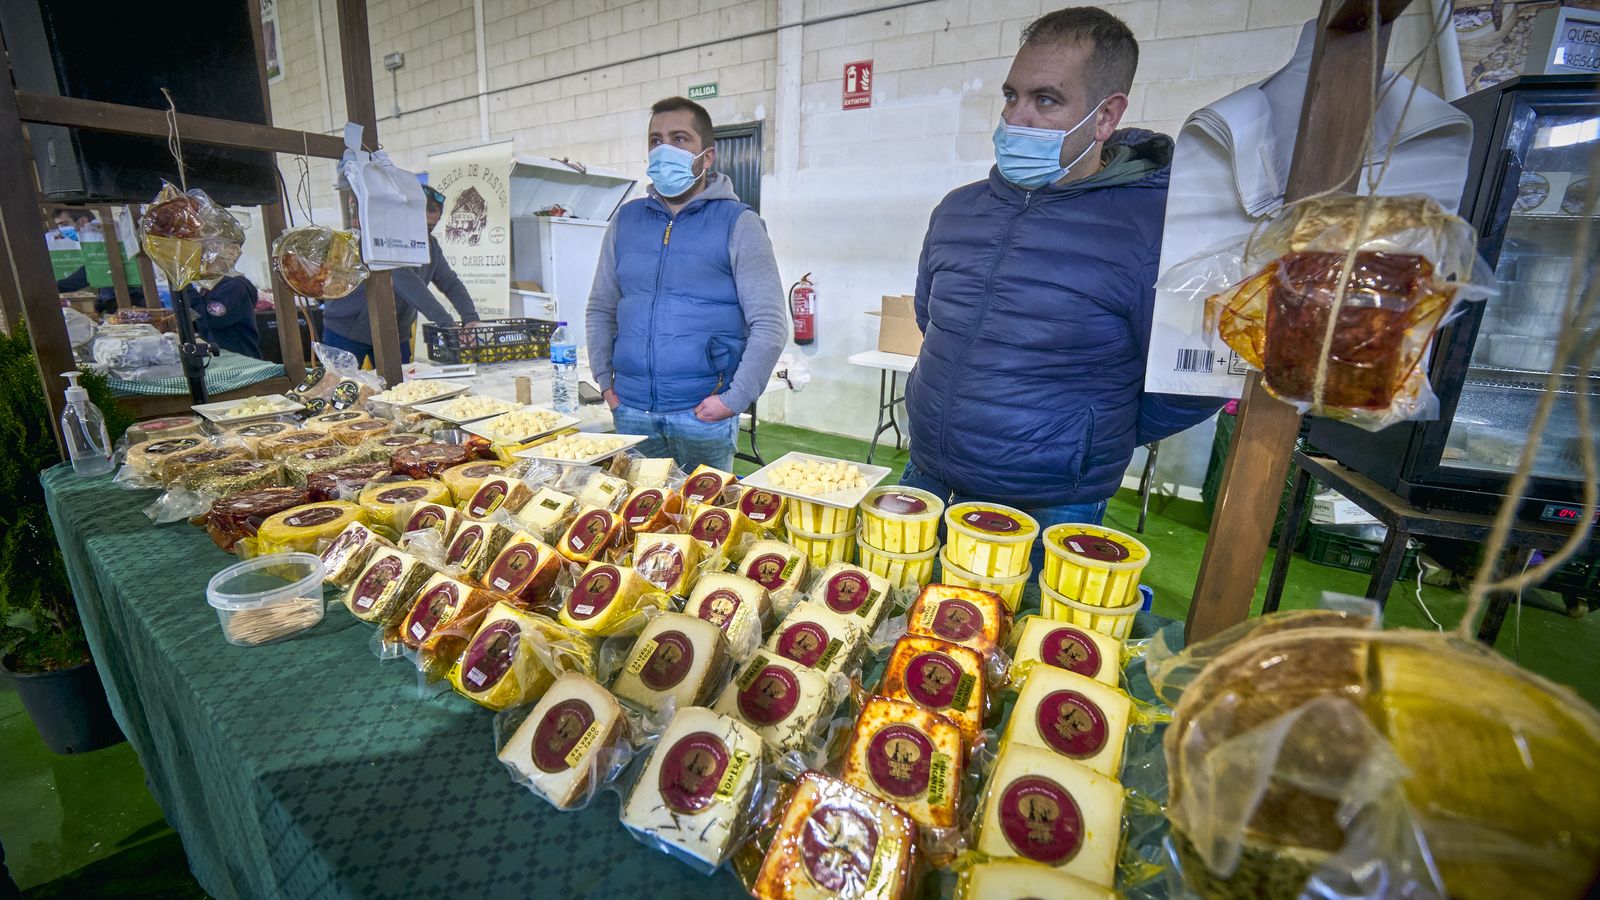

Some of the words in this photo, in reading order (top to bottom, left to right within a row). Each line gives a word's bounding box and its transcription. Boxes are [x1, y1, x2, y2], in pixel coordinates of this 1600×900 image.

[1568, 28, 1600, 44] QUES
[1566, 53, 1600, 69] RESCO
[690, 86, 716, 97] SALIDA
[844, 97, 869, 106] EXTINTOR
[437, 168, 463, 193] SERIA
[467, 163, 479, 177] DE
[462, 255, 505, 267] CARRILLO
[1559, 509, 1577, 518] 04
[861, 593, 876, 614] ROMERO
[631, 643, 650, 669] SALVADO
[642, 646, 654, 661] TRIGO
[821, 642, 839, 666] ROMERO
[742, 660, 763, 686] ROMERO
[571, 726, 596, 758] SALVADO
[575, 753, 582, 762] DE
[584, 730, 599, 749] TRIGO
[721, 756, 744, 796] ROMERO
